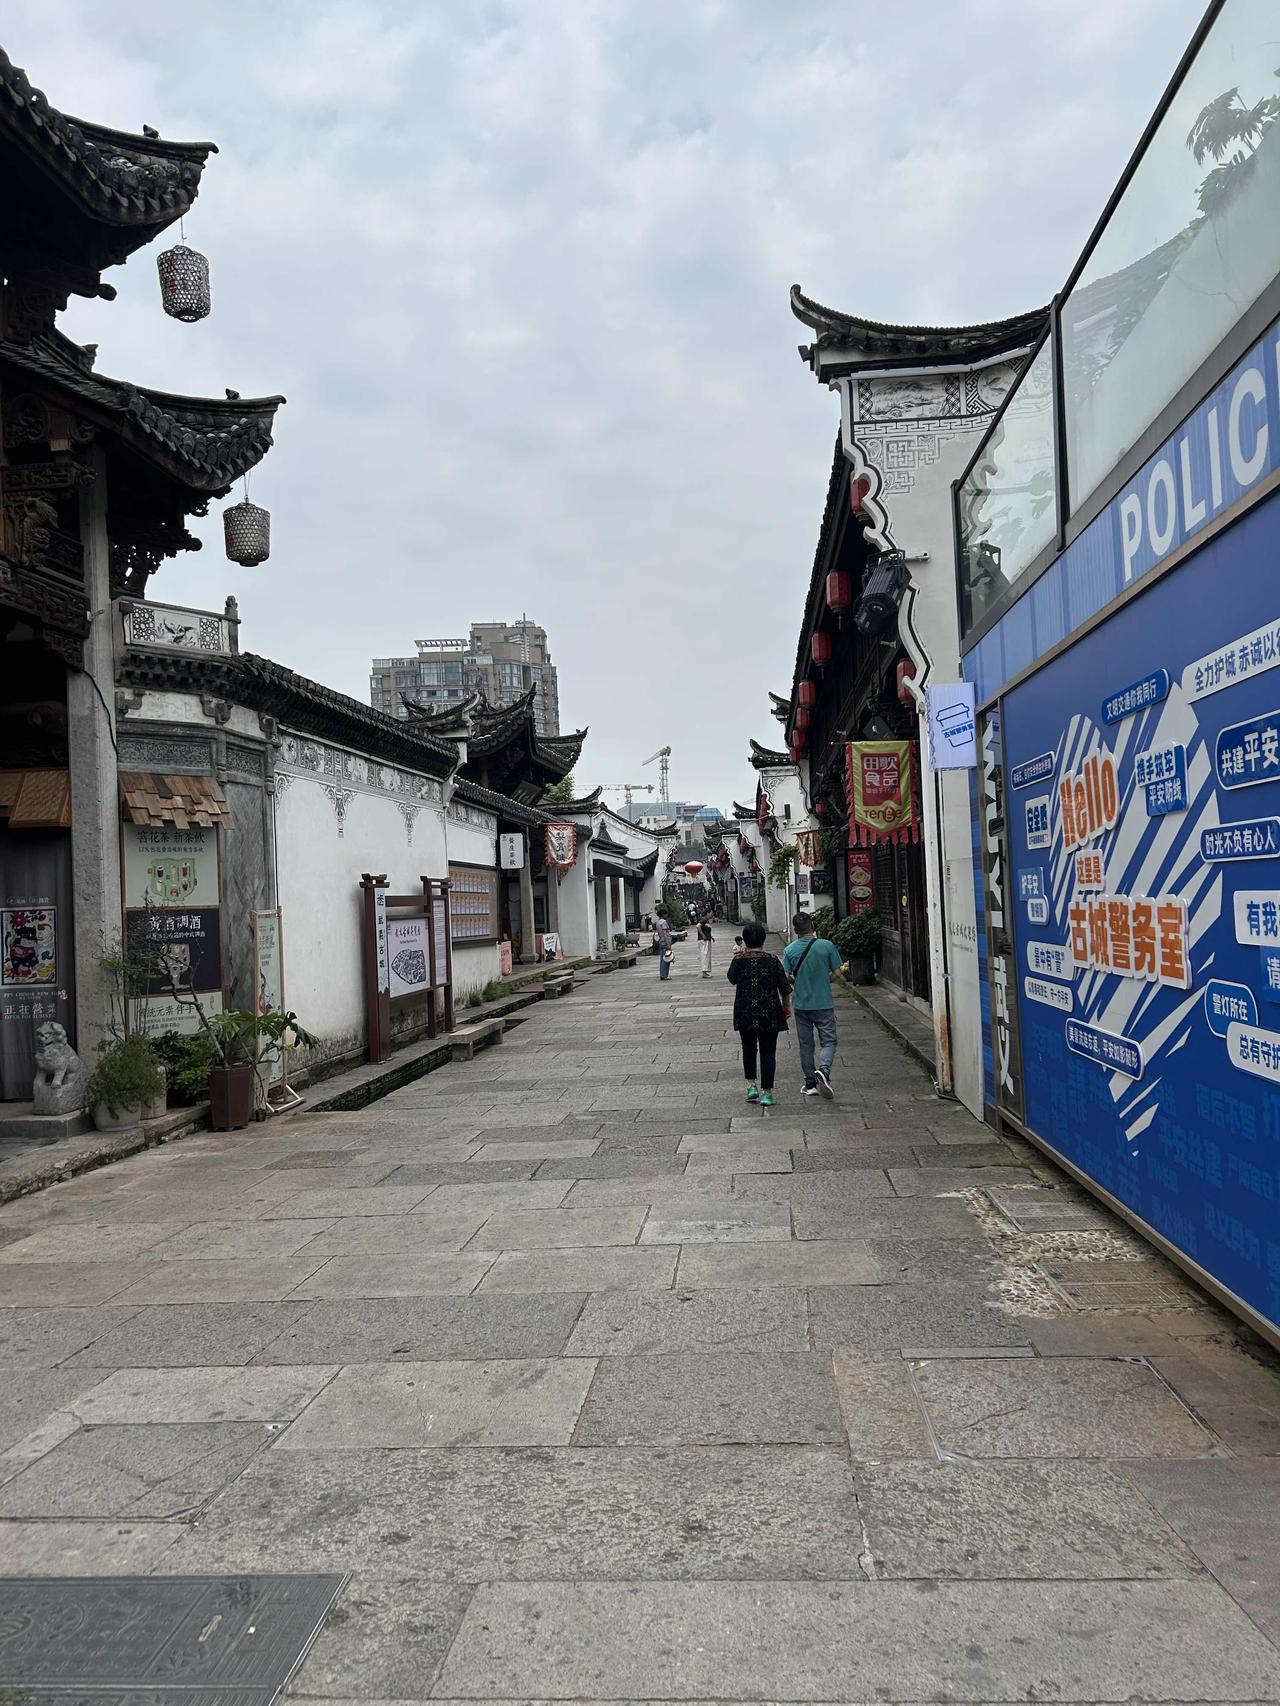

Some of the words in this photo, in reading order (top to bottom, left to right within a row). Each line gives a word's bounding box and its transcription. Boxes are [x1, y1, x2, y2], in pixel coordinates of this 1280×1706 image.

[1121, 340, 1280, 581] POLIC
[1194, 650, 1236, 693] 全力护城
[1106, 678, 1157, 720] 文明交通你我同行
[864, 757, 898, 770] 田歌
[1136, 749, 1176, 780] 携手筑牢
[1221, 727, 1279, 777] 共建平安
[865, 771, 899, 786] 食品
[1060, 754, 1117, 848] Hello
[1148, 783, 1182, 807] 平安防线
[1026, 804, 1048, 834] 安全感
[1205, 825, 1276, 855] 时光不负有心人
[1021, 875, 1039, 895] 护平安
[1077, 856, 1101, 884] 这里是
[1246, 900, 1280, 937] 有我
[1071, 901, 1186, 981] 古城警务室
[1212, 993, 1248, 1021] 警灯所在
